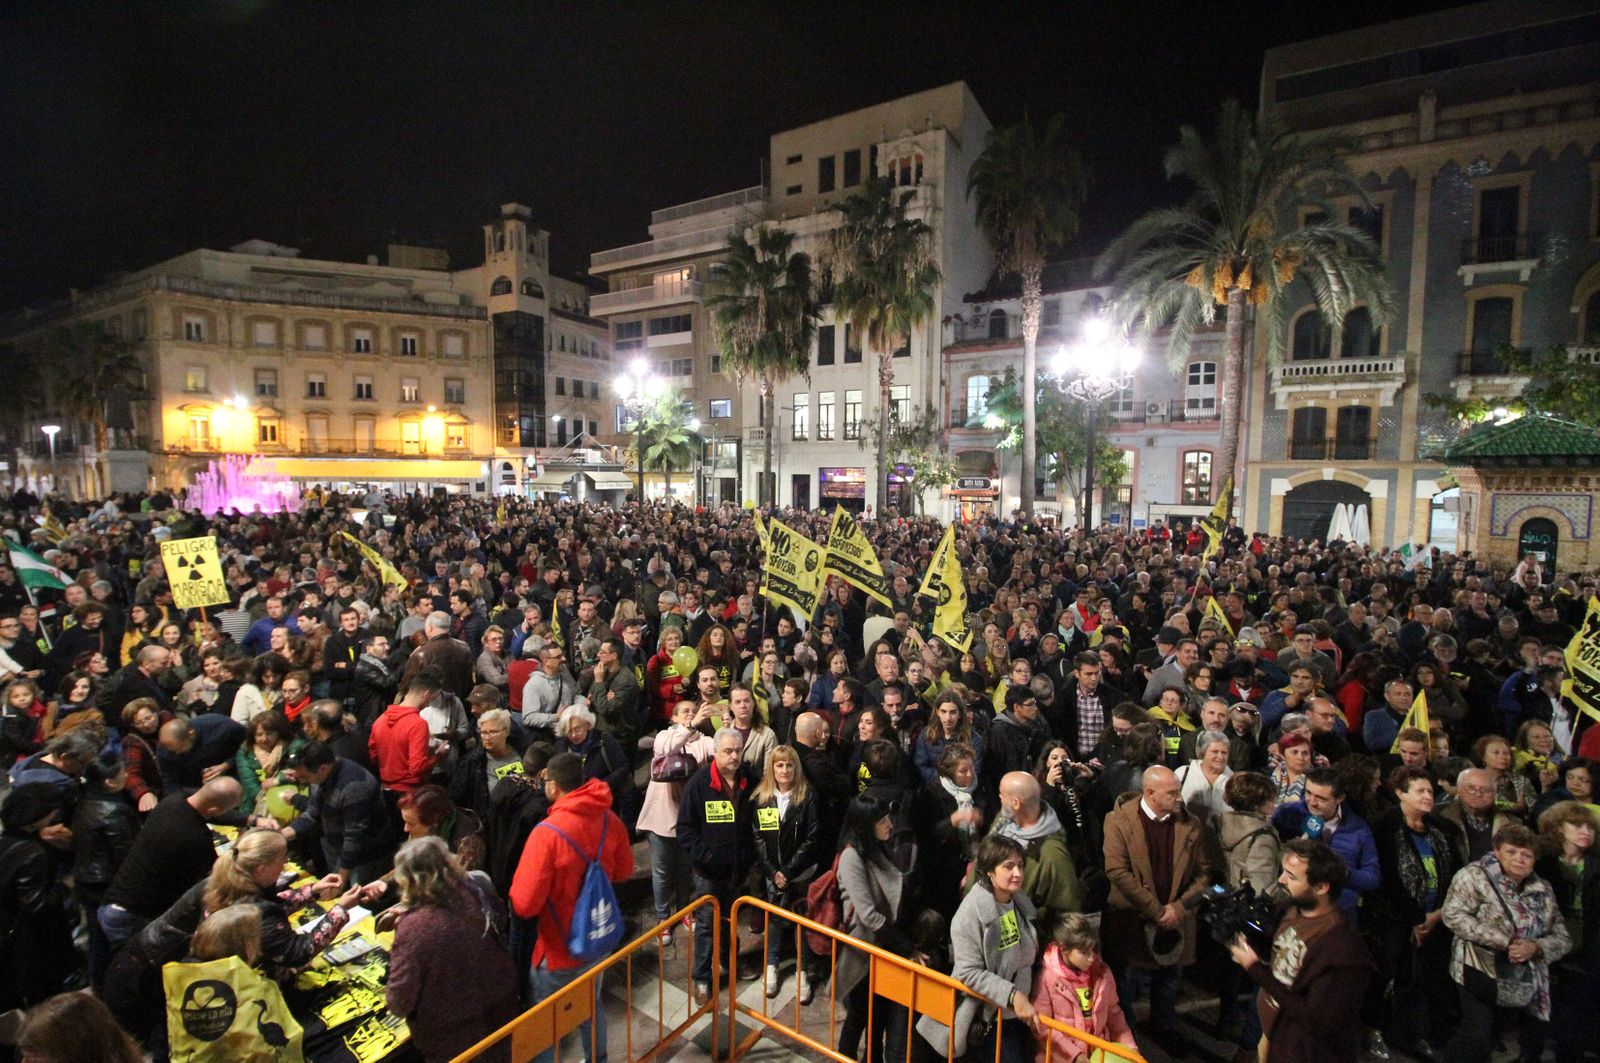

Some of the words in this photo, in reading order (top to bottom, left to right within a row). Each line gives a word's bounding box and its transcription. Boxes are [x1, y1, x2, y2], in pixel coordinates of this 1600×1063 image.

[833, 514, 857, 540] NO
[162, 539, 215, 556] PELIGRO
[770, 527, 791, 556] NO
[173, 579, 225, 597] MARISMA
